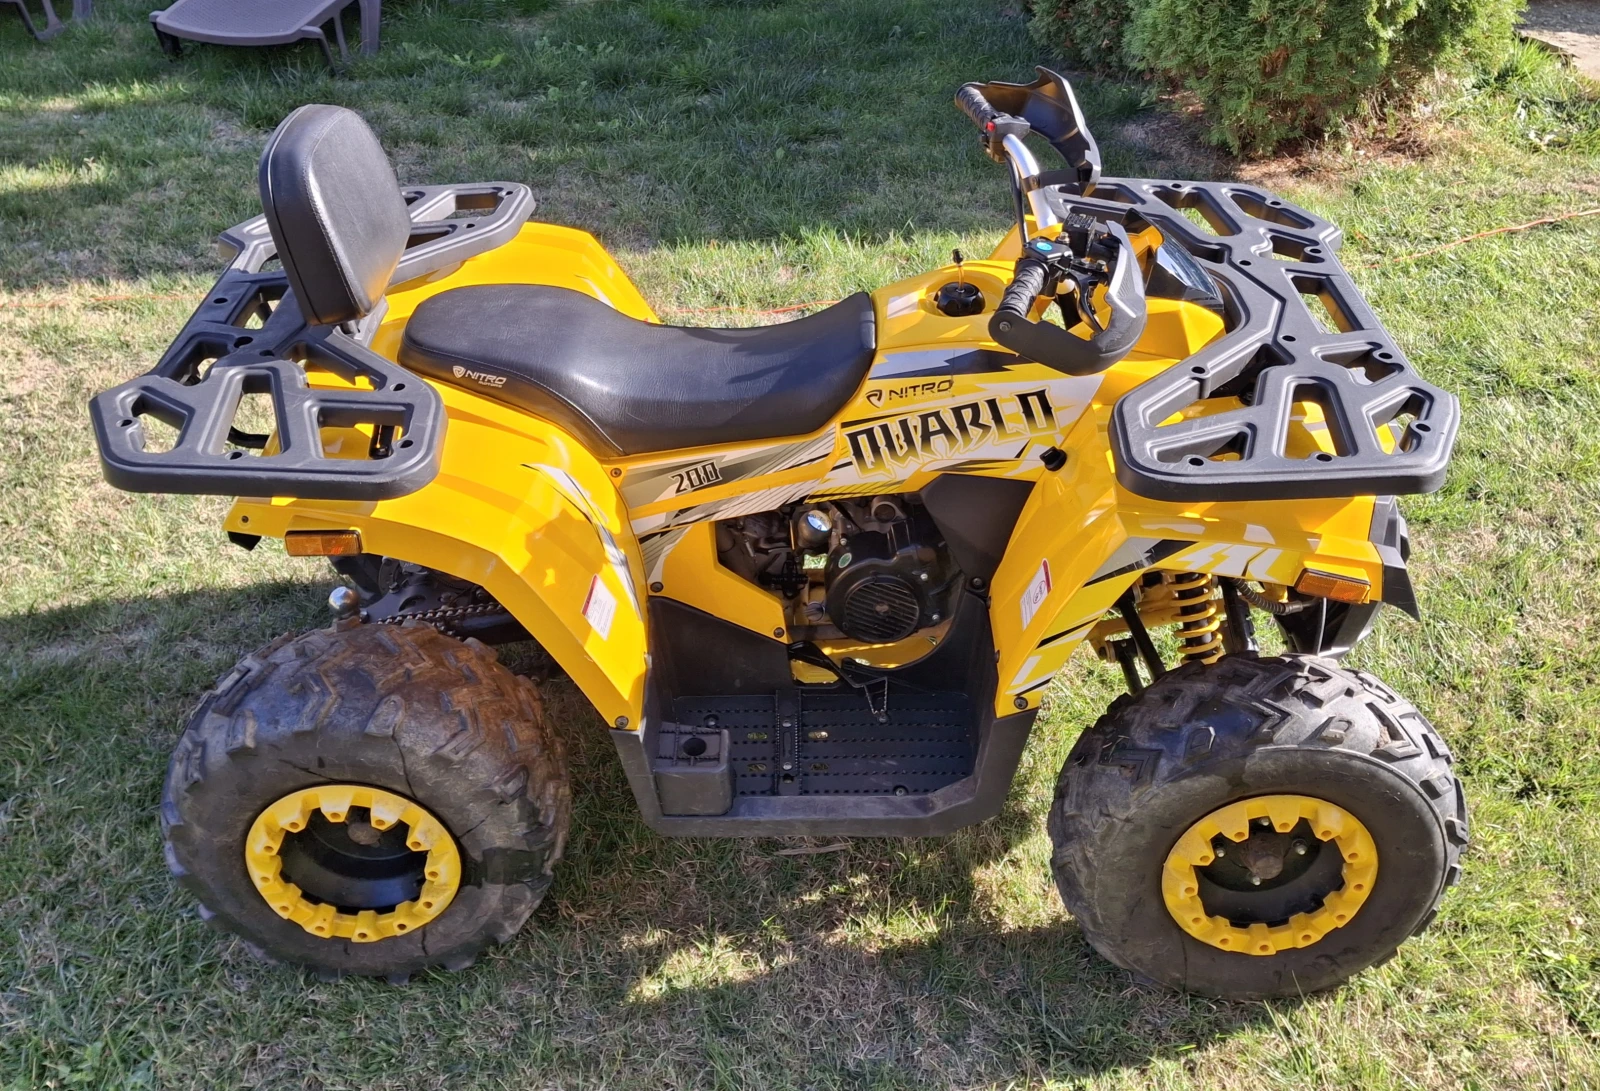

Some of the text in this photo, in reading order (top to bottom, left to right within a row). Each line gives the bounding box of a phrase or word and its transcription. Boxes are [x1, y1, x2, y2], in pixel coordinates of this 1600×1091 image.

[465, 369, 507, 385] NITRO
[888, 379, 955, 401] NITRO
[845, 387, 1060, 477] QUABLO
[670, 461, 721, 495] 200
